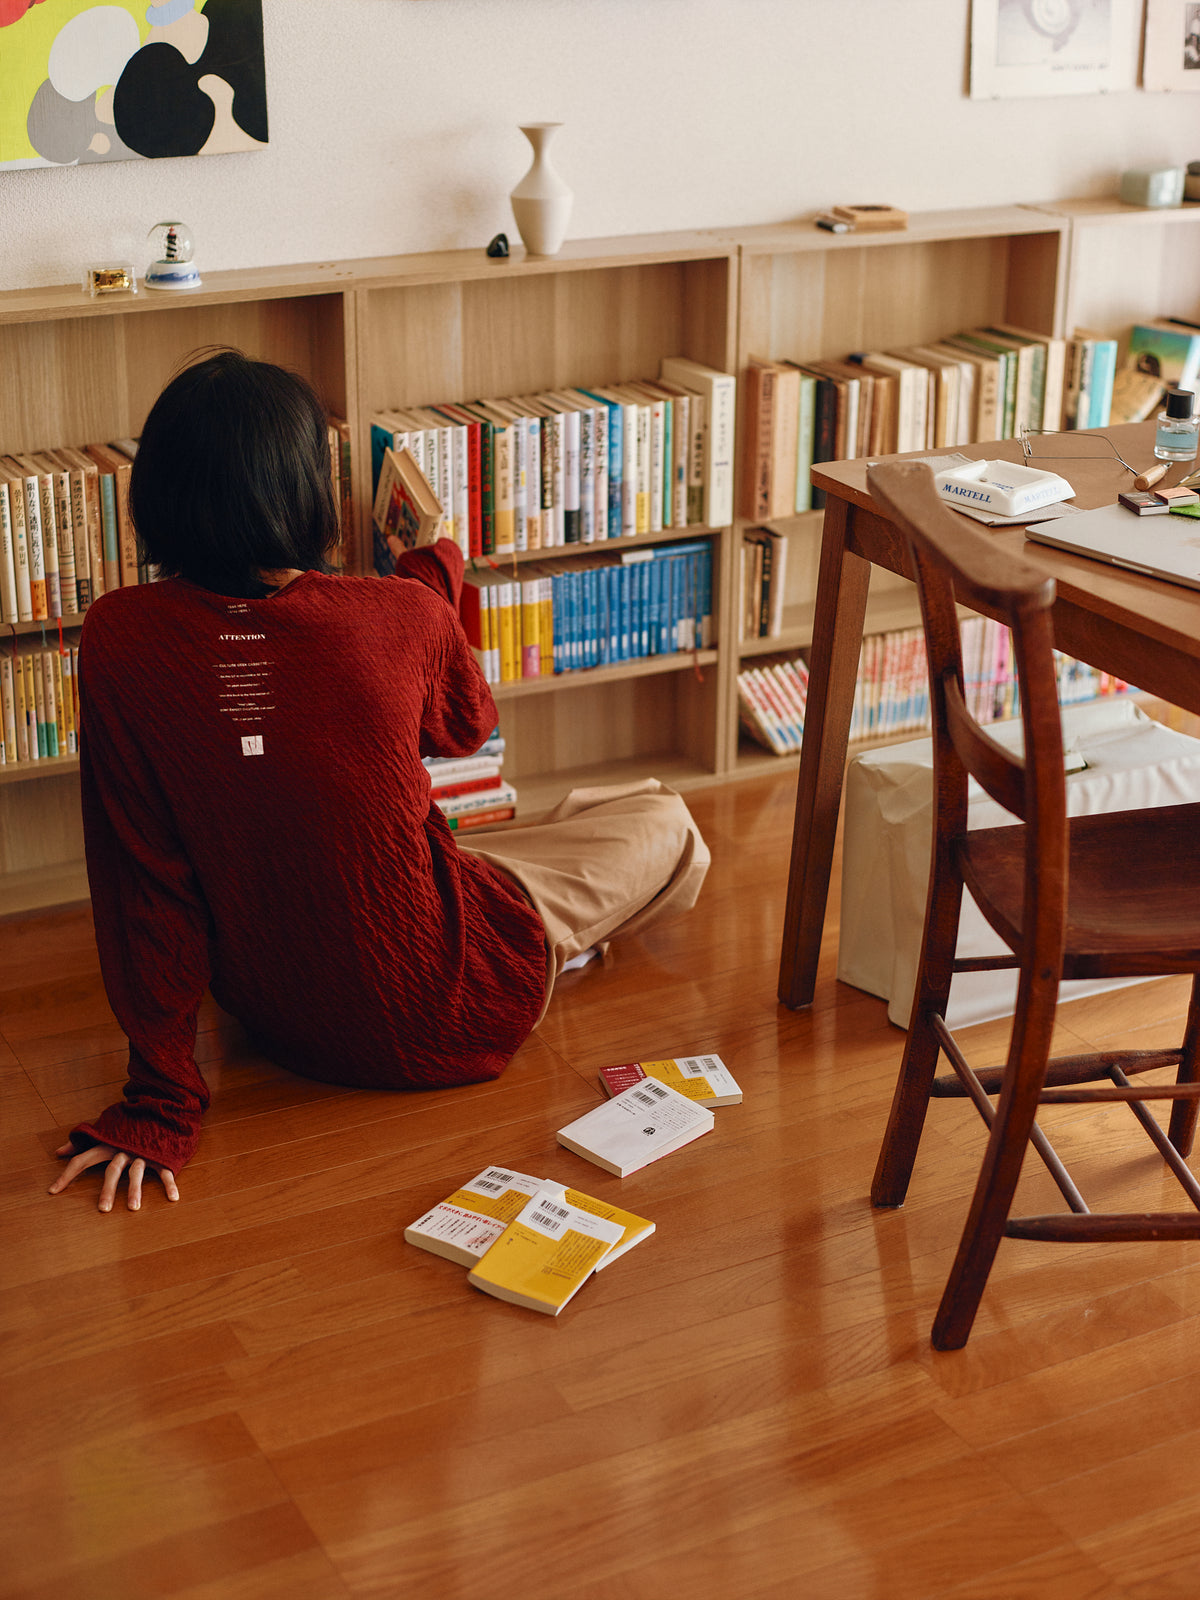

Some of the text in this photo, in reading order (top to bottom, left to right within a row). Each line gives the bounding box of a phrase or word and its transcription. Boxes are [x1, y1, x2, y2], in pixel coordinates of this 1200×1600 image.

[942, 484, 992, 503] MARTELL
[1024, 487, 1060, 504] MARTELL
[218, 633, 266, 641] ATTENTION
